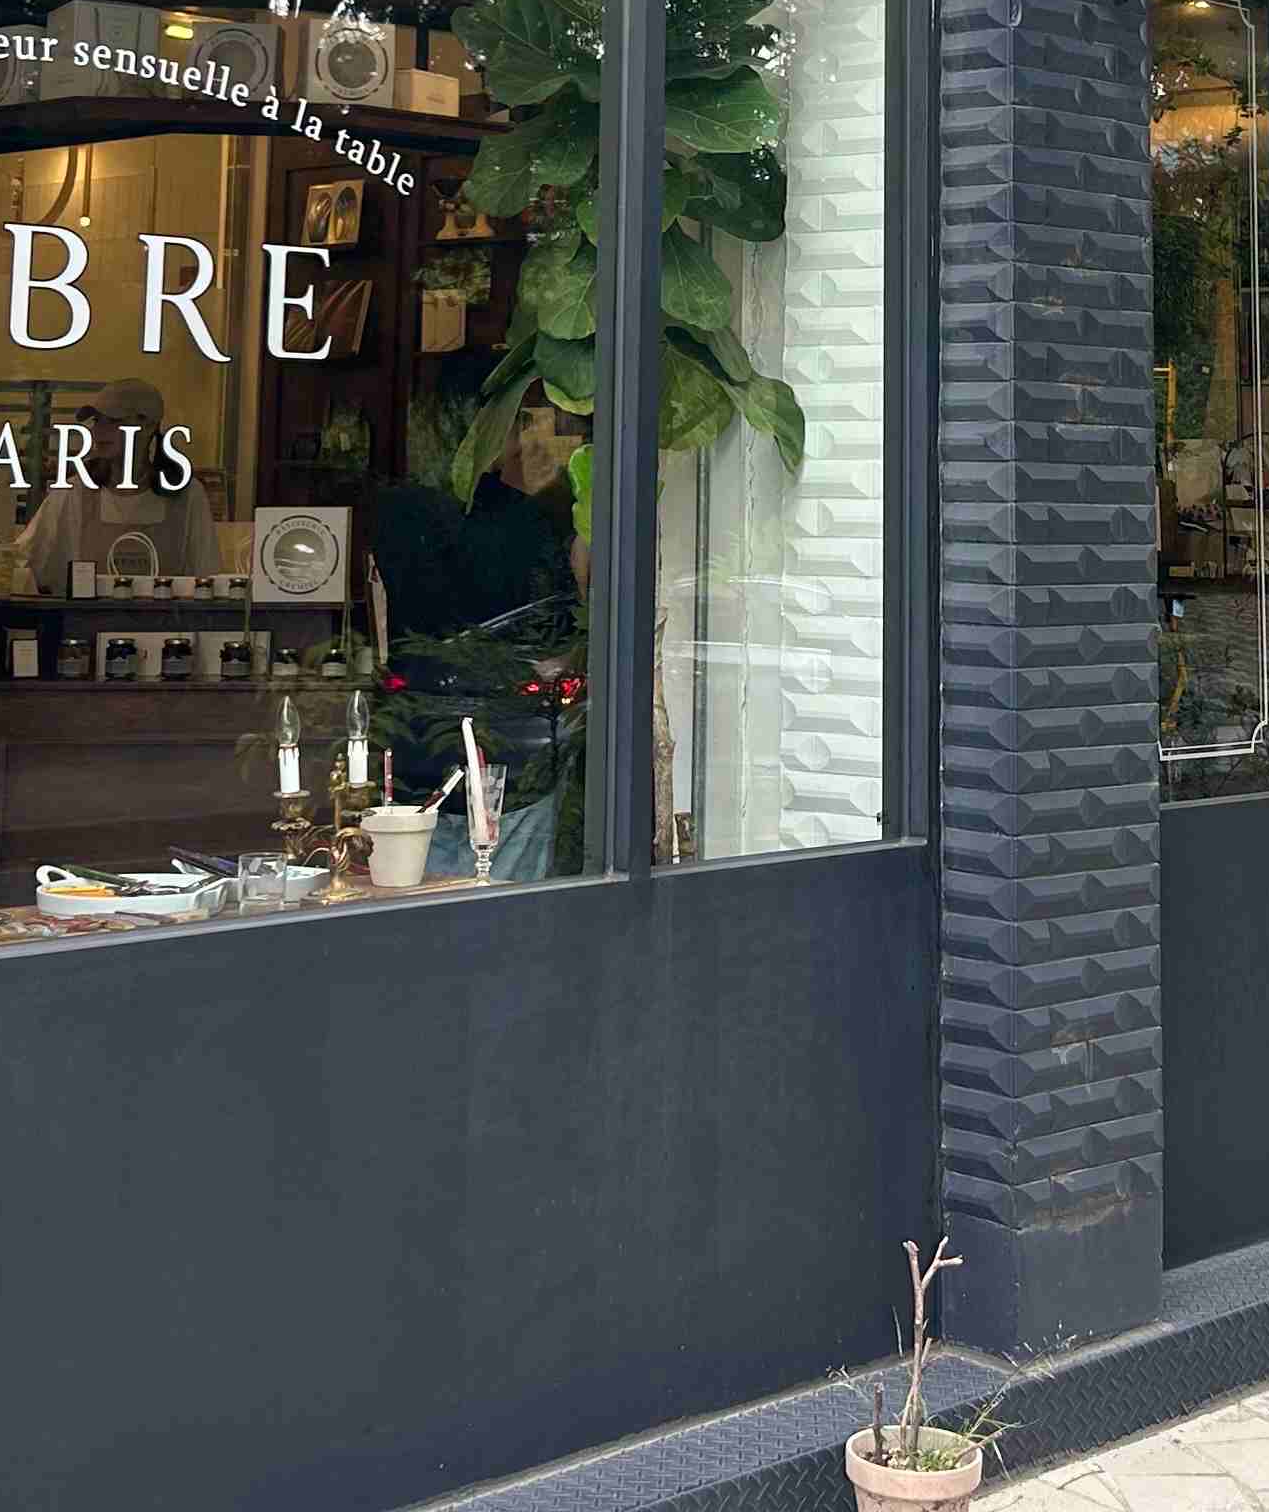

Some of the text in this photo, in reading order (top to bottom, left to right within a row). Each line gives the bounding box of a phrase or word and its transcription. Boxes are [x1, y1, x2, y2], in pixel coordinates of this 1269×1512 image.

[73, 40, 249, 108] sensuelle
[261, 85, 279, 121] à
[291, 98, 323, 142] la
[334, 128, 415, 196] table
